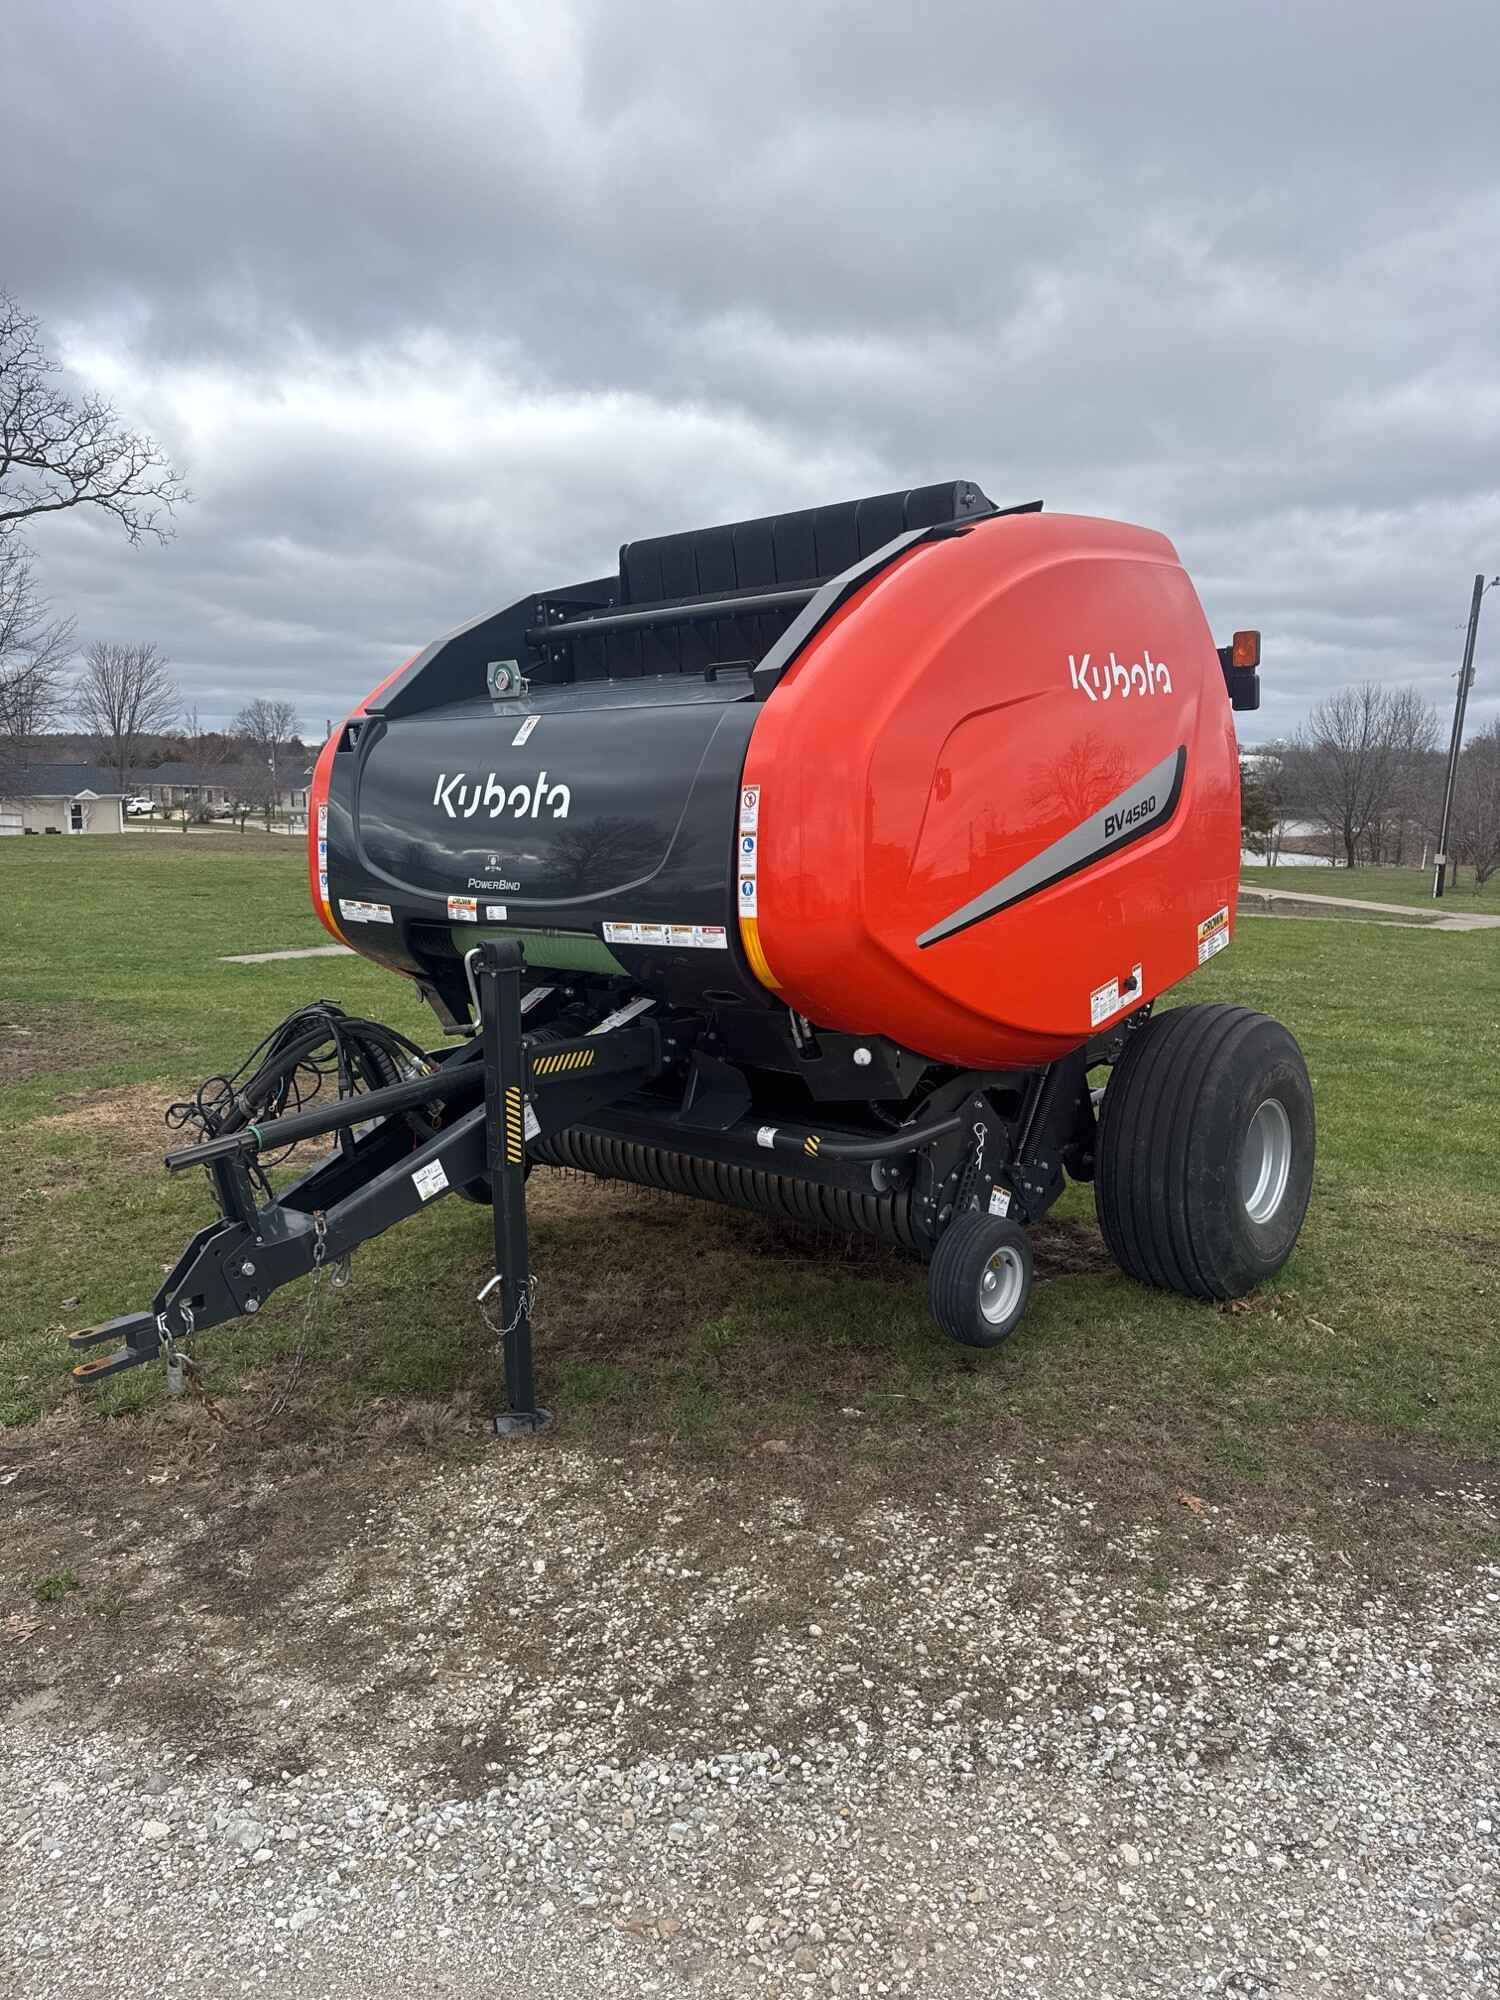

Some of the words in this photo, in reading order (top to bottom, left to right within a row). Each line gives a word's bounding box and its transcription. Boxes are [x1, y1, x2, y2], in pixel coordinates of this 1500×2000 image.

[1068, 650, 1172, 701] Kubota
[433, 771, 571, 818] Kubota
[1104, 795, 1156, 838] BV4580
